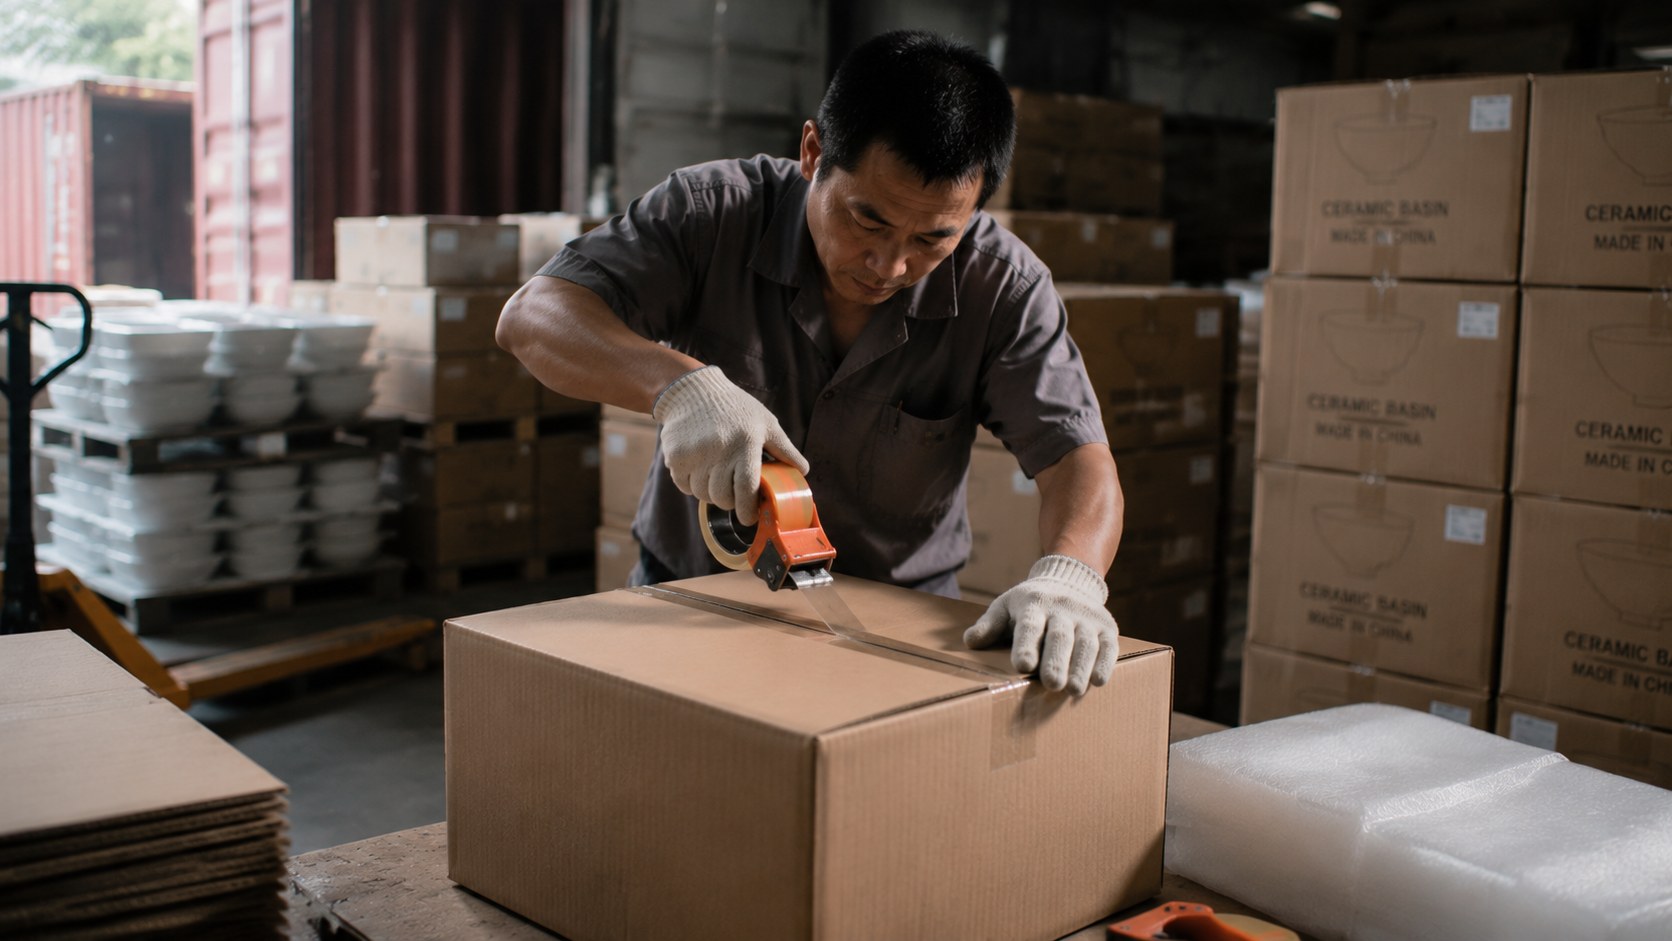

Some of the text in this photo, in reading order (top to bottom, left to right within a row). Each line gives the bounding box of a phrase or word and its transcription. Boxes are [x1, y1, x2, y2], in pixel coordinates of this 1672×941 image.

[1321, 199, 1449, 218] CERAMIC BASIN
[1585, 204, 1672, 222] CERAMIC
[1593, 234, 1641, 251] MADE
[1647, 234, 1665, 251] IN
[1306, 393, 1437, 422] CERAMIC BASIN
[1575, 420, 1664, 445] CERAMIC
[1584, 450, 1631, 471] MADE
[1637, 456, 1656, 474] IN
[1299, 581, 1428, 620] CERAMIC BASIN
[1563, 630, 1649, 662] CERAMIC
[1572, 660, 1618, 687] MADE
[1623, 671, 1640, 691] IN
